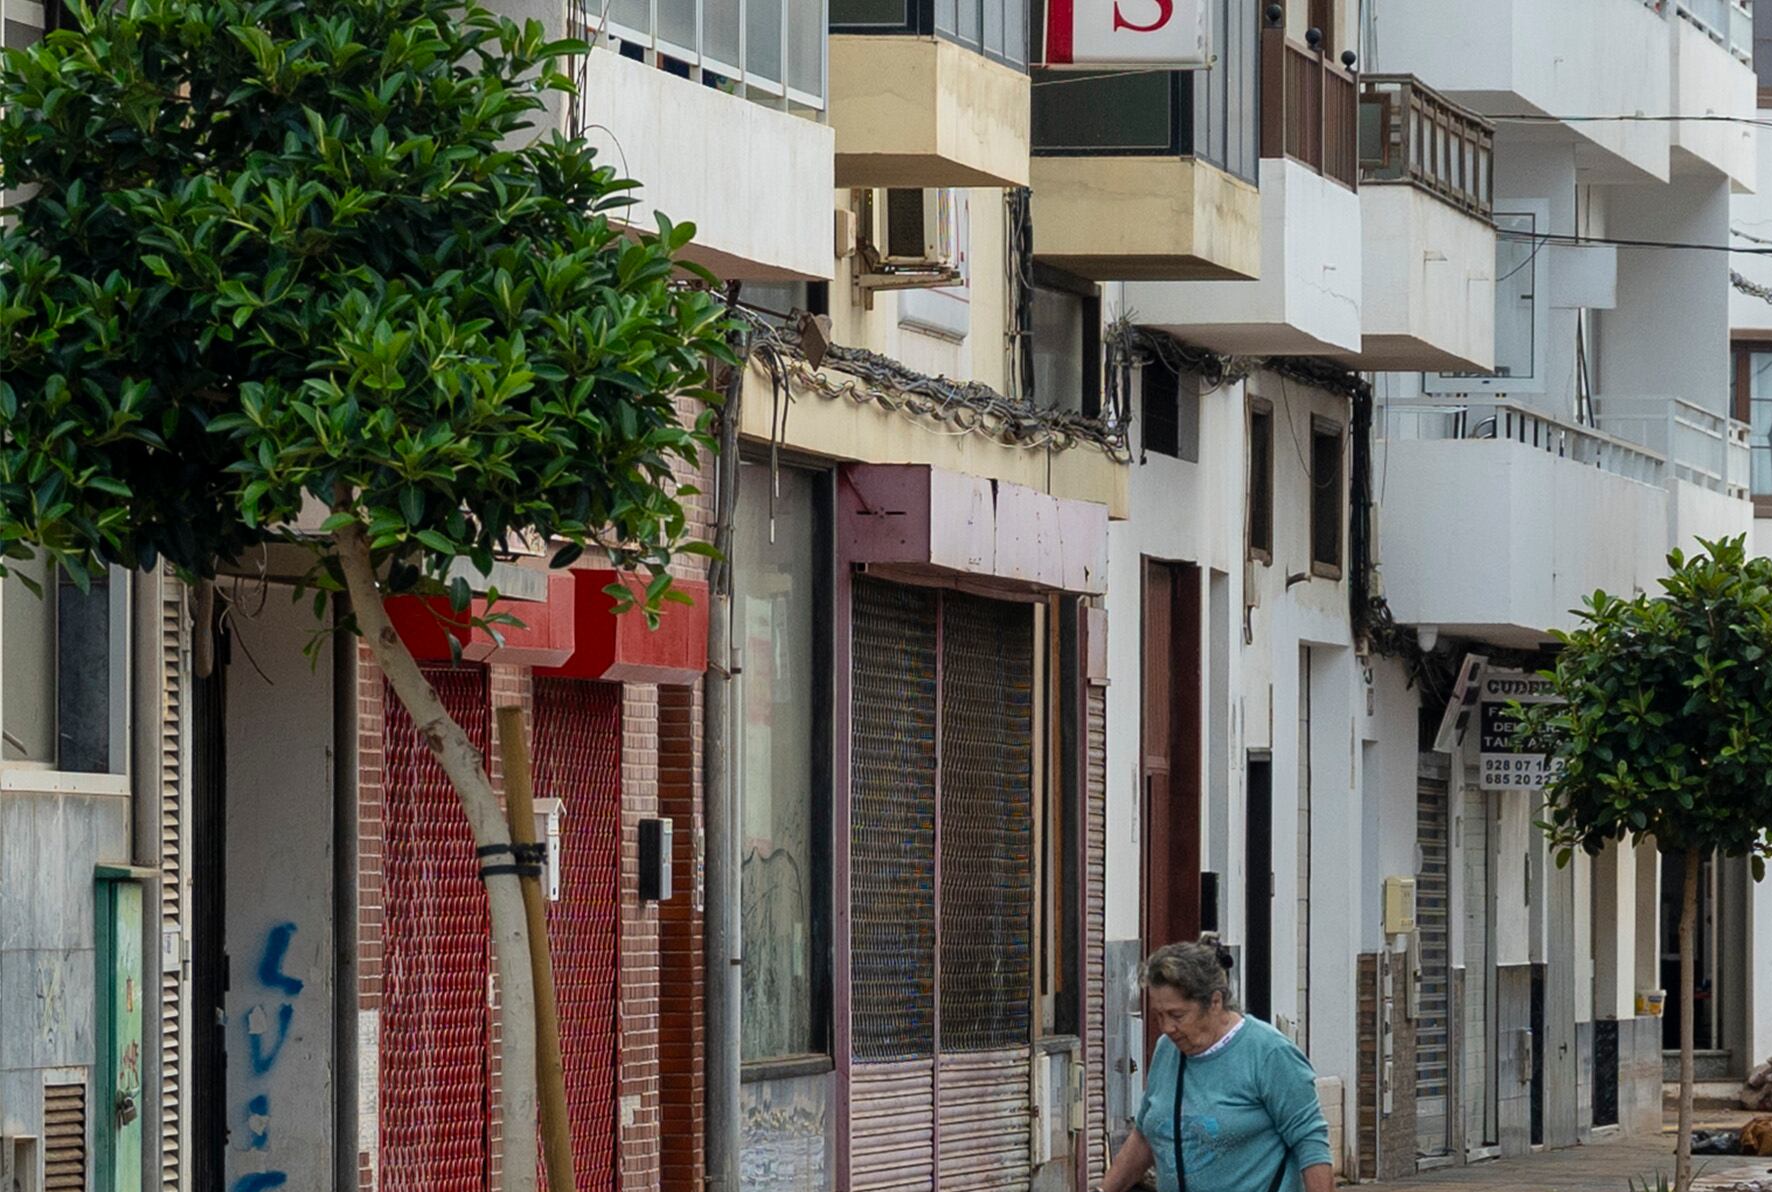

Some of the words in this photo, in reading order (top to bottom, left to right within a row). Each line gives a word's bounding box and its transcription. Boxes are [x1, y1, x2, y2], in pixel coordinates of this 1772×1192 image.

[1486, 759, 1510, 771] 928
[1515, 760, 1531, 771] 07
[1515, 774, 1530, 785] 20
